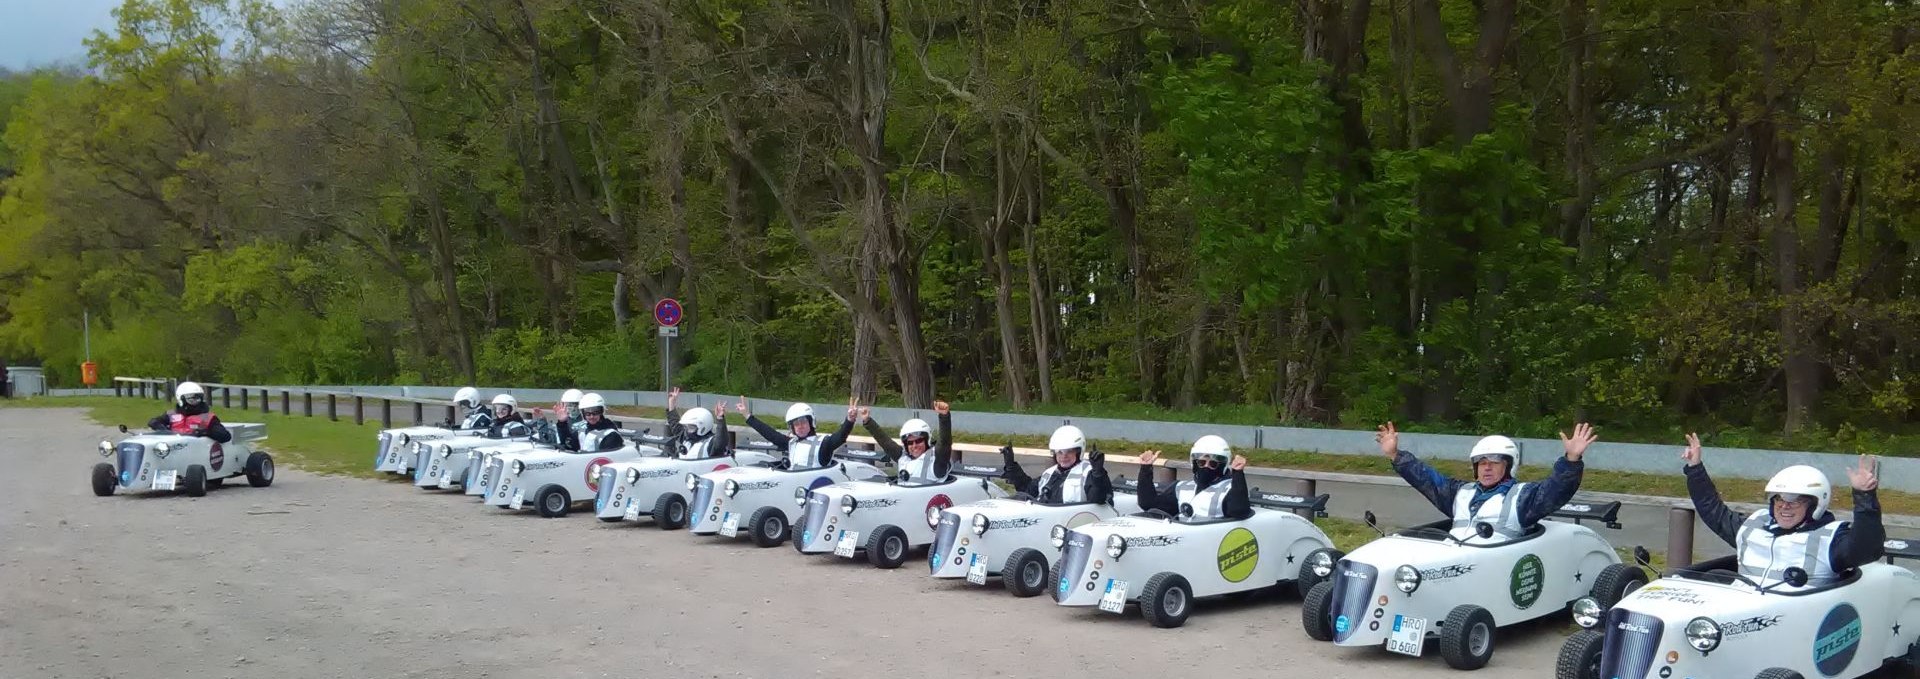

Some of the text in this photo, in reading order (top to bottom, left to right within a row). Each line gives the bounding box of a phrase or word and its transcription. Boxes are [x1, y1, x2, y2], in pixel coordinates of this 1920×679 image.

[1220, 544, 1258, 571] piste
[1113, 580, 1126, 591] HRO
[1108, 601, 1121, 611] 127
[1402, 617, 1420, 630] HRO
[1724, 621, 1742, 636] Rod
[1741, 619, 1761, 633] Fun
[1391, 640, 1397, 650] D
[1815, 627, 1860, 661] piste
